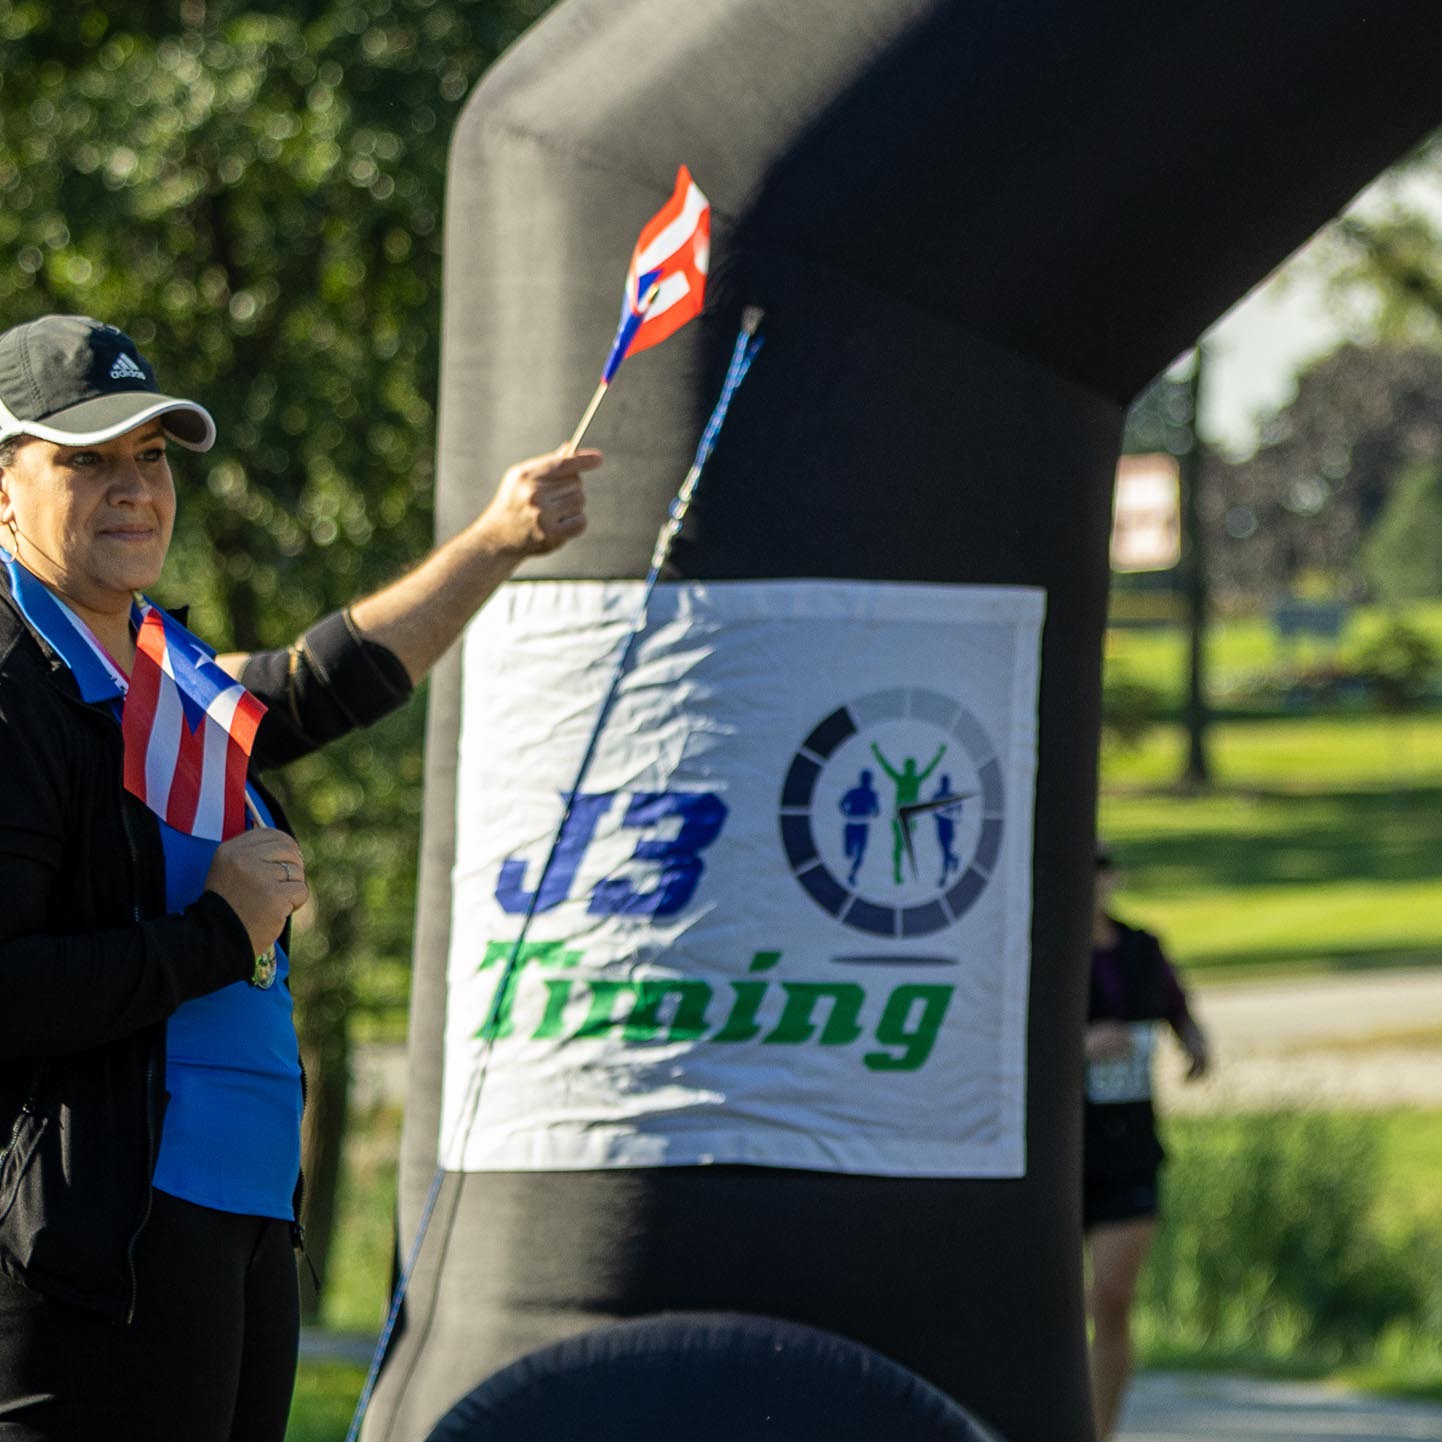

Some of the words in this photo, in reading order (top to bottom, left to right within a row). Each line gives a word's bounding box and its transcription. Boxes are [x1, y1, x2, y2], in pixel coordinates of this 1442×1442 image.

[110, 368, 146, 380] adidas
[494, 791, 730, 916] J3
[471, 940, 955, 1072] Timing
